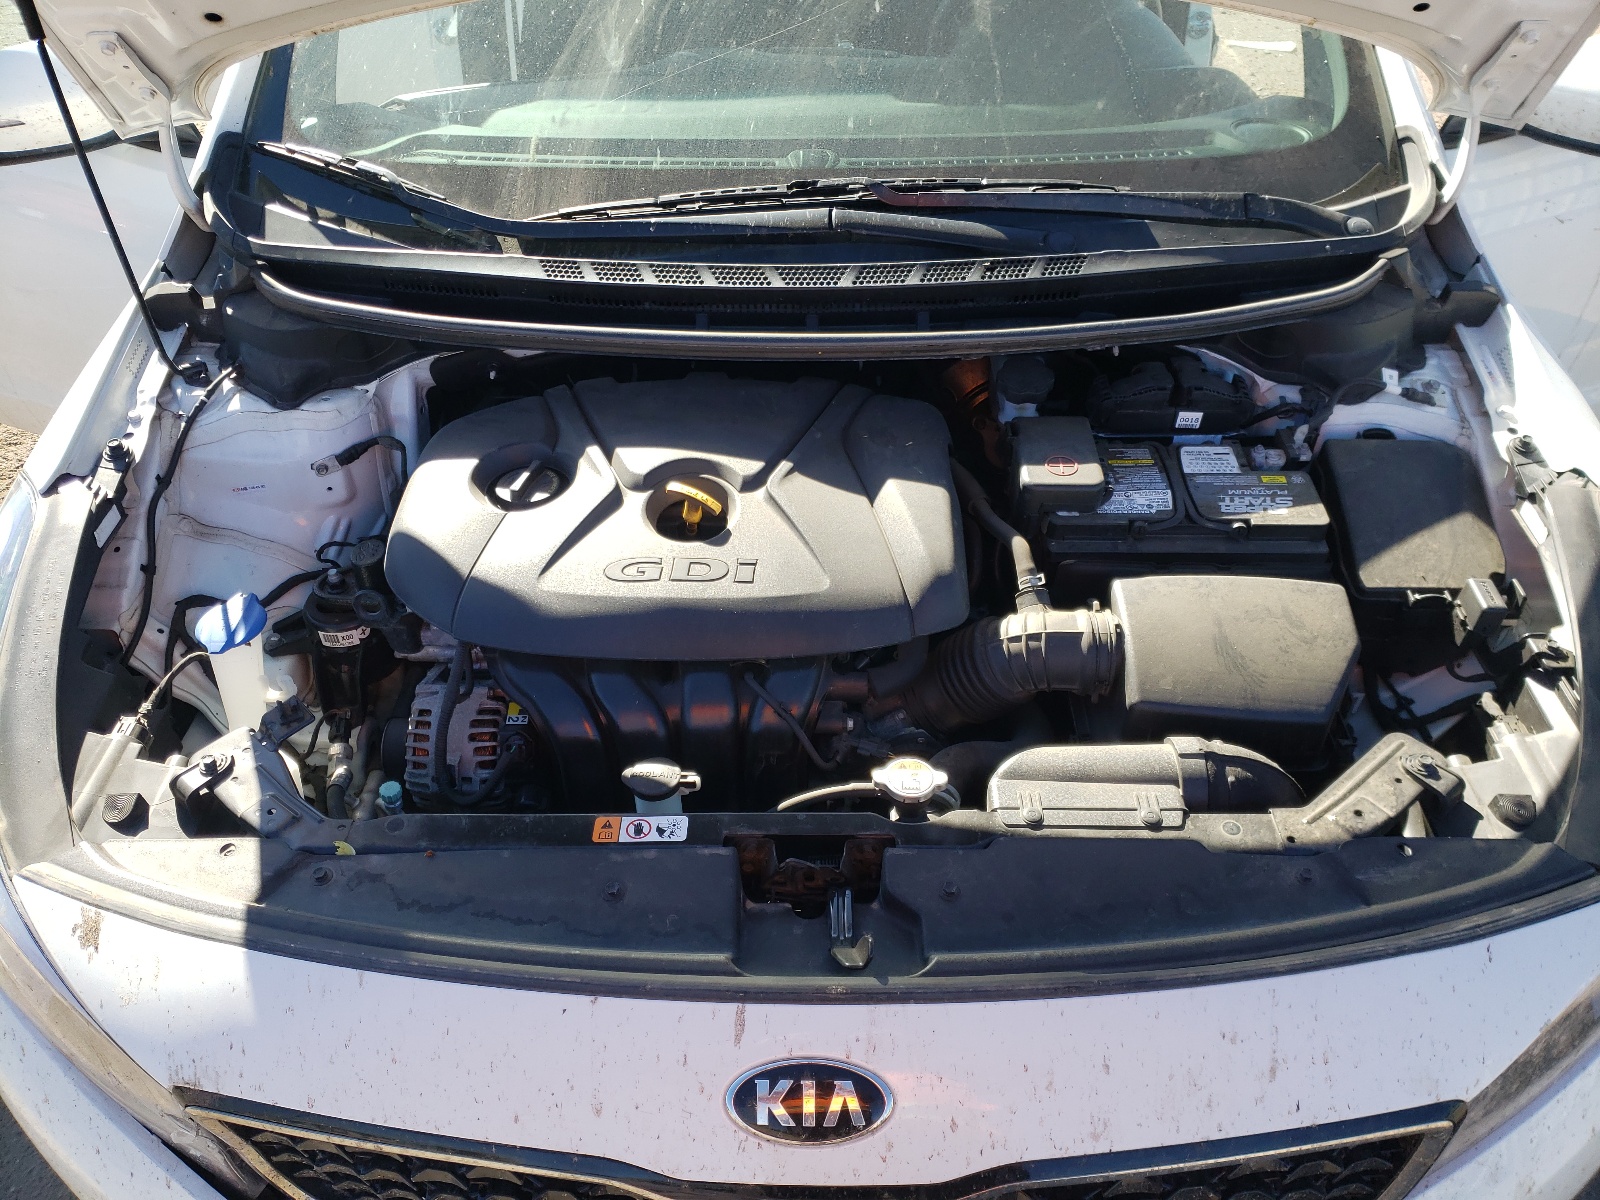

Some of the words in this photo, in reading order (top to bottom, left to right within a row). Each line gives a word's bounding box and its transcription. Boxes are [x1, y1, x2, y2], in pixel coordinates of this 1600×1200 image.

[1218, 496, 1293, 506] START
[603, 557, 758, 583] GDi
[631, 771, 680, 780] COOLANT
[754, 1079, 866, 1127] KIA
